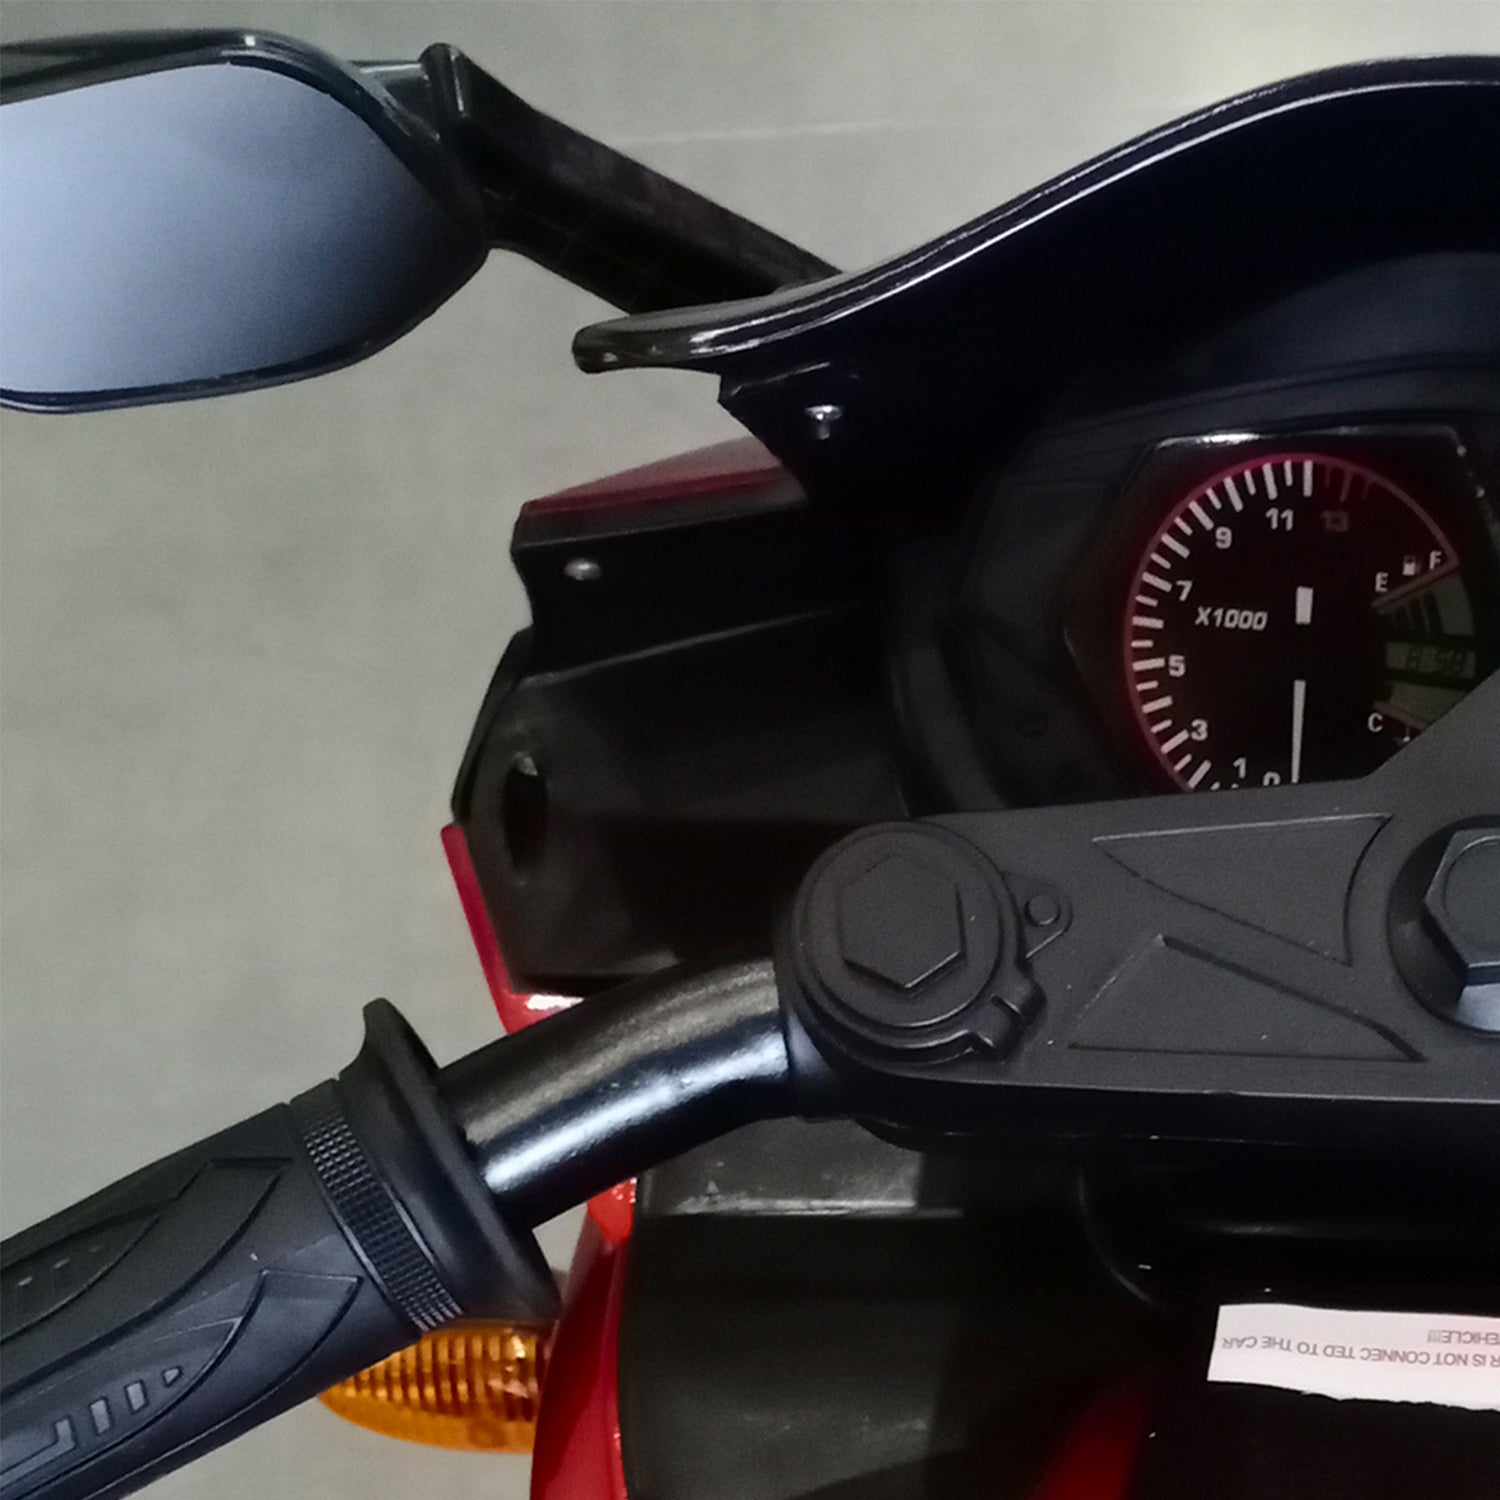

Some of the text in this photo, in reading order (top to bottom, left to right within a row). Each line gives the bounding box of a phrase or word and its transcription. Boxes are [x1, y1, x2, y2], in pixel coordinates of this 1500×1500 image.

[1265, 508, 1294, 531] 11
[1321, 510, 1348, 532] 13
[1215, 526, 1232, 549] 9
[1375, 551, 1442, 592] E F
[1176, 580, 1192, 601] 7
[1195, 607, 1268, 630] X1000
[1169, 655, 1185, 677] 5
[1191, 719, 1208, 741] 3
[1368, 713, 1383, 732] C
[1233, 758, 1247, 779] 1
[1221, 1335, 1258, 1349] CAR
[1261, 1335, 1292, 1352] THE
[1297, 1341, 1319, 1356] TO
[1434, 1352, 1468, 1366] NOT
[1472, 1354, 1487, 1367] IS
